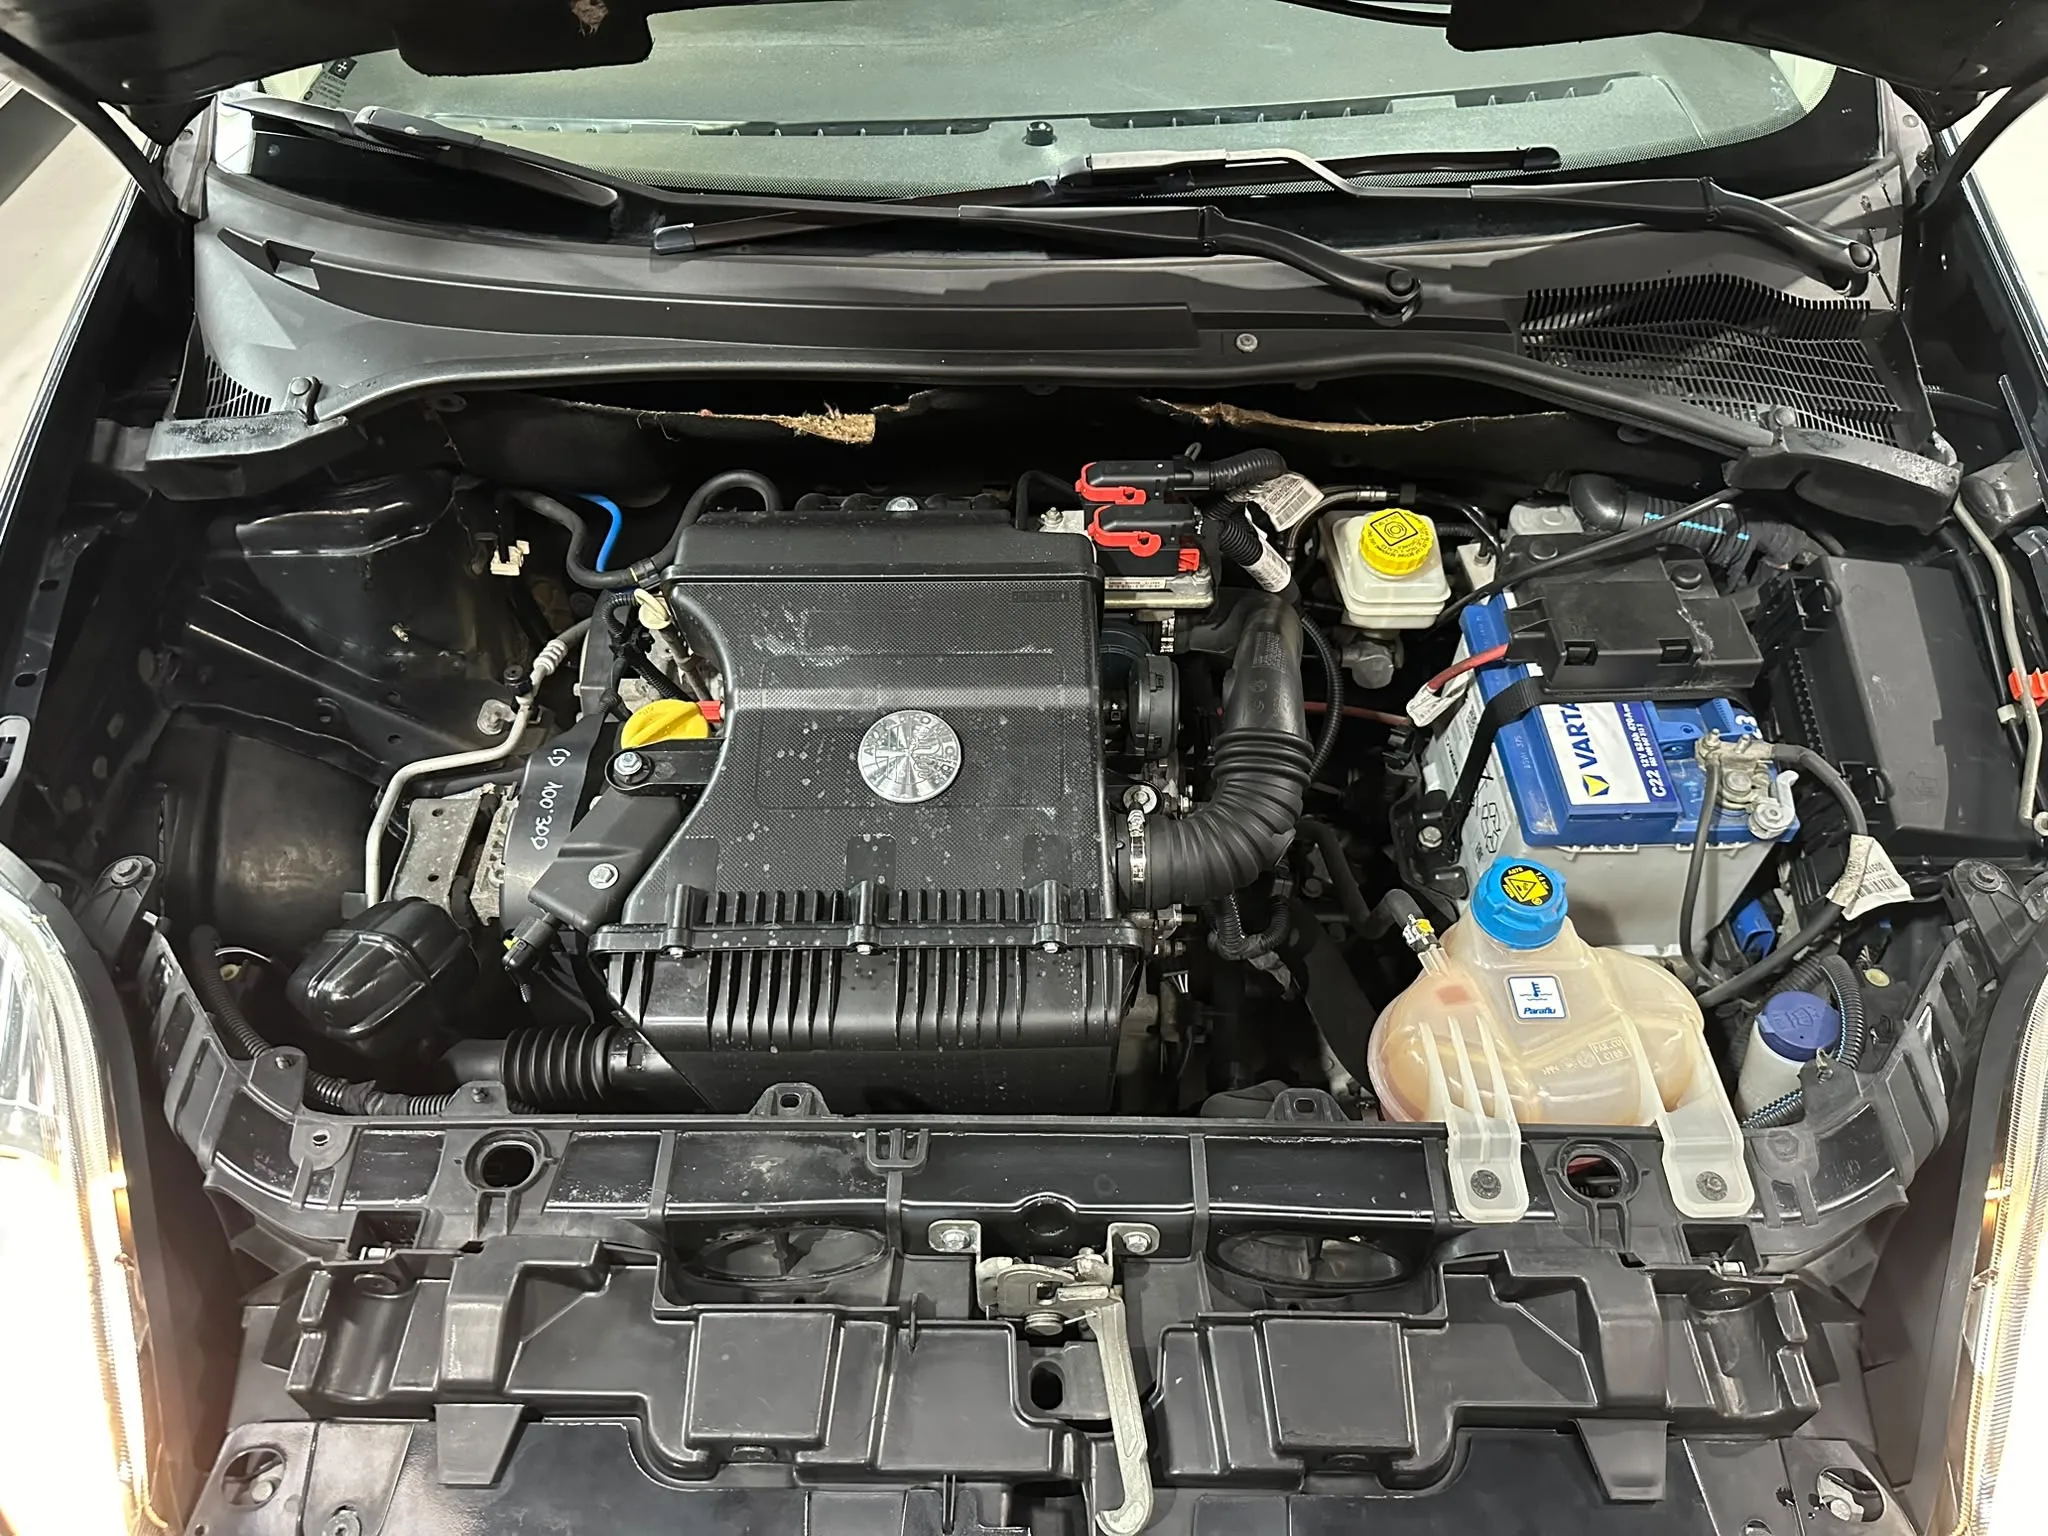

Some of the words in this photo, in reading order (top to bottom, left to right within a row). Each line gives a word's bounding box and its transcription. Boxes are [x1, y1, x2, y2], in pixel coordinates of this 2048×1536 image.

[1637, 752, 1651, 768] 12V
[1646, 770, 1667, 797] C22
[1523, 1006, 1556, 1015] Paraflu
